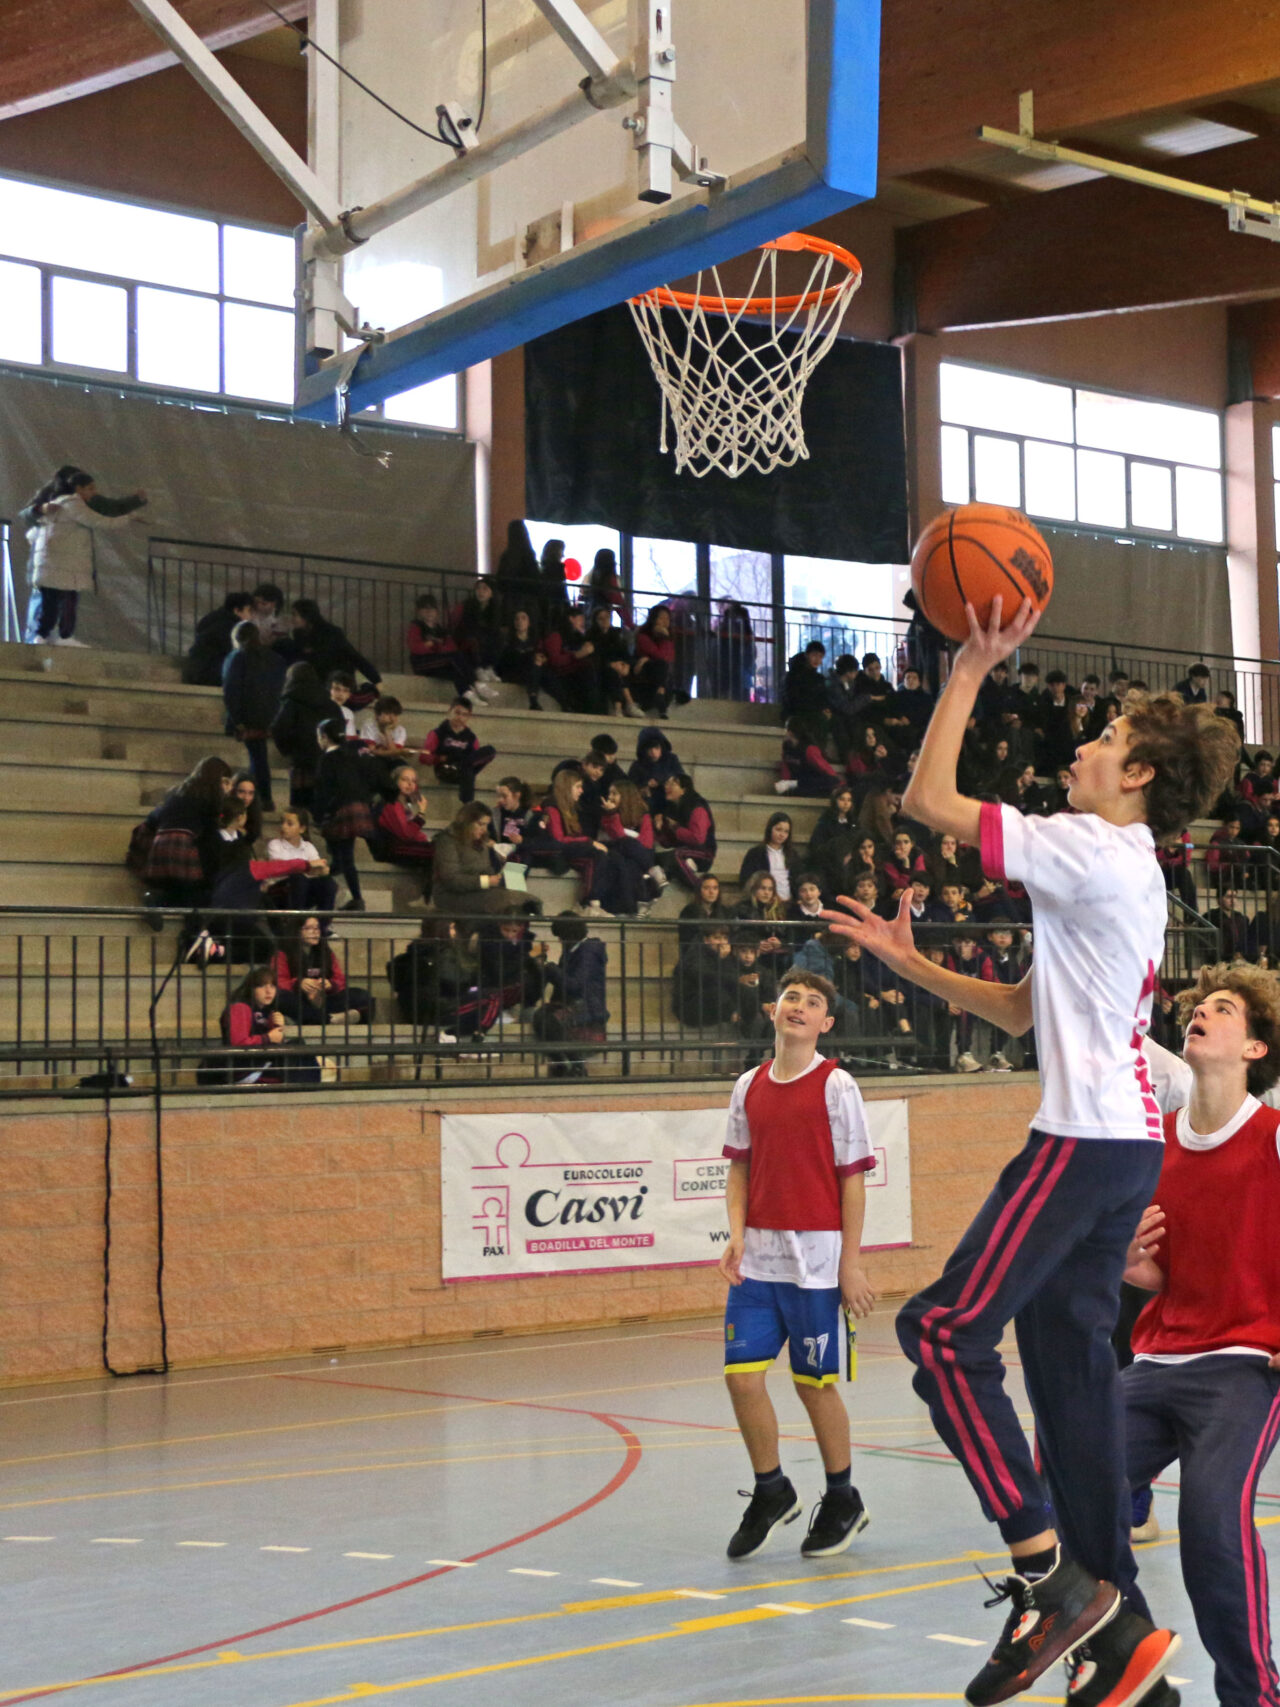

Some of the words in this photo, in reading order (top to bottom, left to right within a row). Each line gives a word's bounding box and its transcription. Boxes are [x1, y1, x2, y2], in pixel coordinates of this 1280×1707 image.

[563, 1167, 644, 1181] EUROCOLEGIO
[525, 1185, 649, 1228] Casvi
[483, 1246, 504, 1257] PAX
[530, 1240, 586, 1252] BOADILLA
[589, 1239, 610, 1248] DEL
[612, 1236, 650, 1247] MONTE
[803, 1332, 829, 1369] 27
